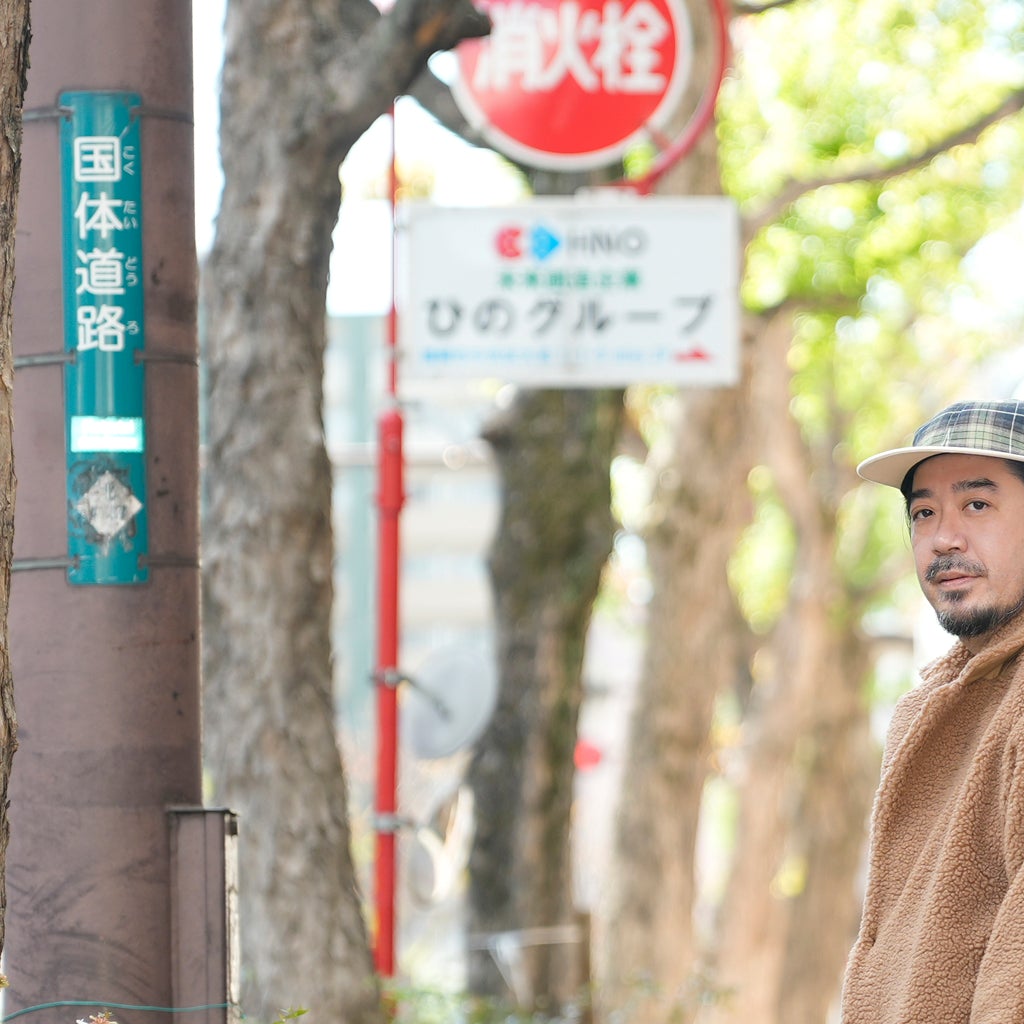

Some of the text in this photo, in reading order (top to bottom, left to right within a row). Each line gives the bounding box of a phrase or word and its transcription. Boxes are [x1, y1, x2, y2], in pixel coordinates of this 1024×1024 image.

[474, 0, 670, 92] 消火栓
[73, 136, 125, 352] 国体道路
